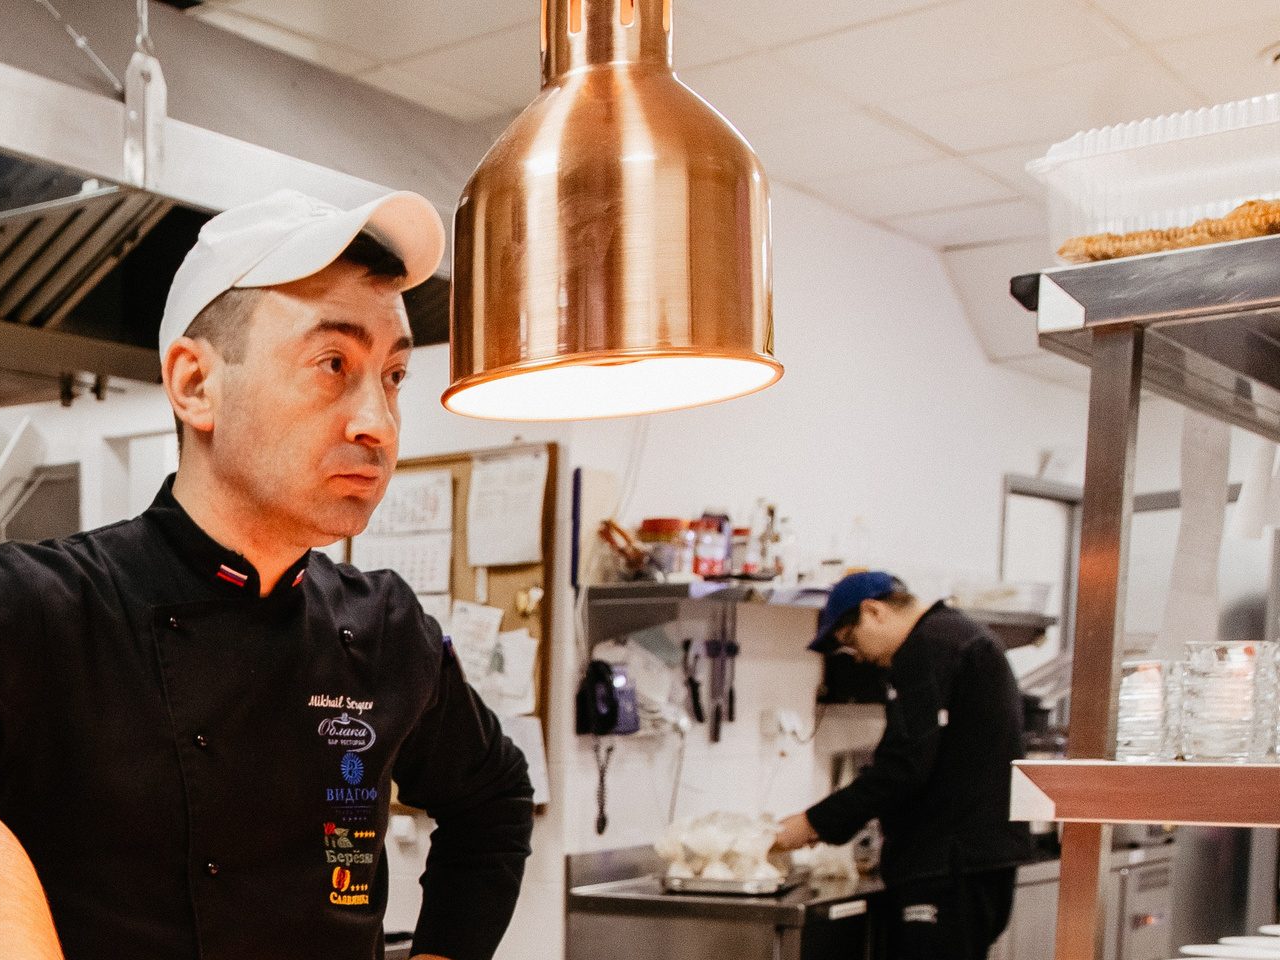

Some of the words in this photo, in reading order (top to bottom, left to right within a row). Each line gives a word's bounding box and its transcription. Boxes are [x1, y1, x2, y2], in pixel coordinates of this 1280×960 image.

[308, 694, 344, 708] Mikhail
[317, 718, 368, 736] Облака
[326, 787, 378, 803] ВИДГОФ
